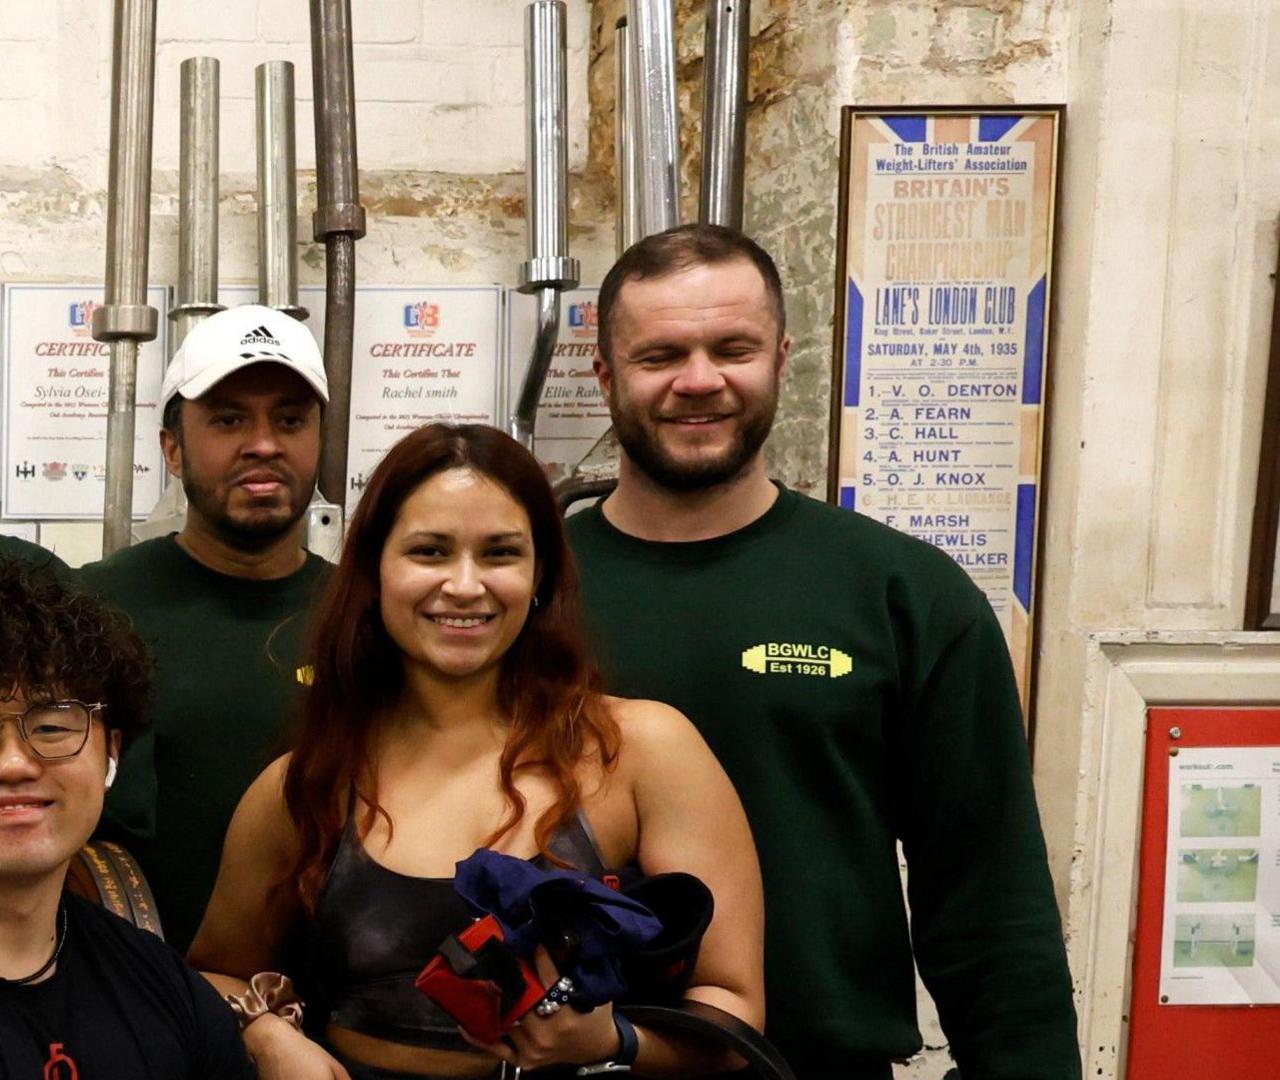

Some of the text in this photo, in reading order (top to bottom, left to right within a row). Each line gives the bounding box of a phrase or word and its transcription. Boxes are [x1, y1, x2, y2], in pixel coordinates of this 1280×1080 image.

[894, 143, 1012, 156] The British Amateur
[876, 158, 1028, 174] Weight-Lifters' Association
[894, 177, 1010, 198] BRITAIN'S
[873, 199, 1026, 241] STRONGEST MAN
[886, 239, 1012, 281] CHAMPIONSHIP
[875, 286, 1017, 326] LANE'S LONDON CLUB
[874, 328, 889, 337] King
[240, 336, 281, 346] adidas
[35, 342, 144, 358] CERTIFICE
[370, 342, 477, 358] CERTIFICATE
[867, 342, 1018, 357] SATURDAY, MAY 4th, 1935
[910, 358, 923, 367] AT
[958, 358, 979, 367] P.M.
[47, 368, 105, 379] This Certifies
[382, 369, 461, 379] This Certifies That
[34, 385, 107, 400] Sylvia Osei-
[382, 386, 458, 399] Rachel smith
[545, 386, 603, 399] Ellie Rah
[918, 384, 935, 398] O.
[947, 384, 1017, 397] DENTON
[915, 407, 971, 420] FEARN
[915, 427, 959, 439] HALL
[913, 450, 962, 462] HUNT
[913, 473, 925, 486] J.
[935, 472, 986, 485] KNOX
[909, 515, 970, 528] MARSH
[767, 642, 829, 659] BGWLC
[770, 662, 827, 676] Est 1926
